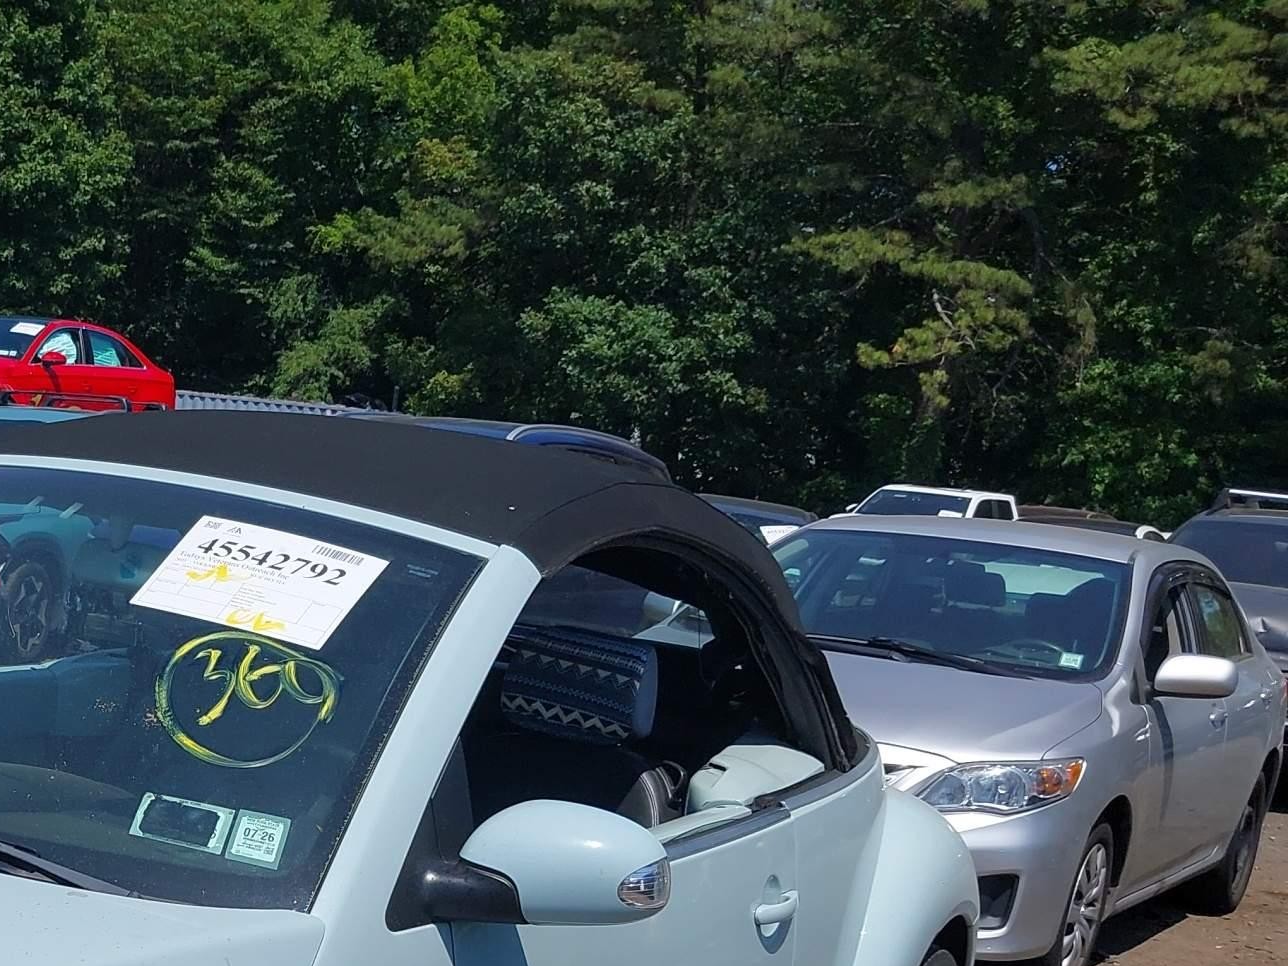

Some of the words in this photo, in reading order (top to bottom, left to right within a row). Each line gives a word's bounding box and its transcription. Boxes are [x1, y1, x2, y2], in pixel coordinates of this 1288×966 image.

[197, 537, 347, 587] 45542792
[193, 642, 326, 727] 360
[243, 827, 258, 838] 07
[260, 831, 276, 842] 26
